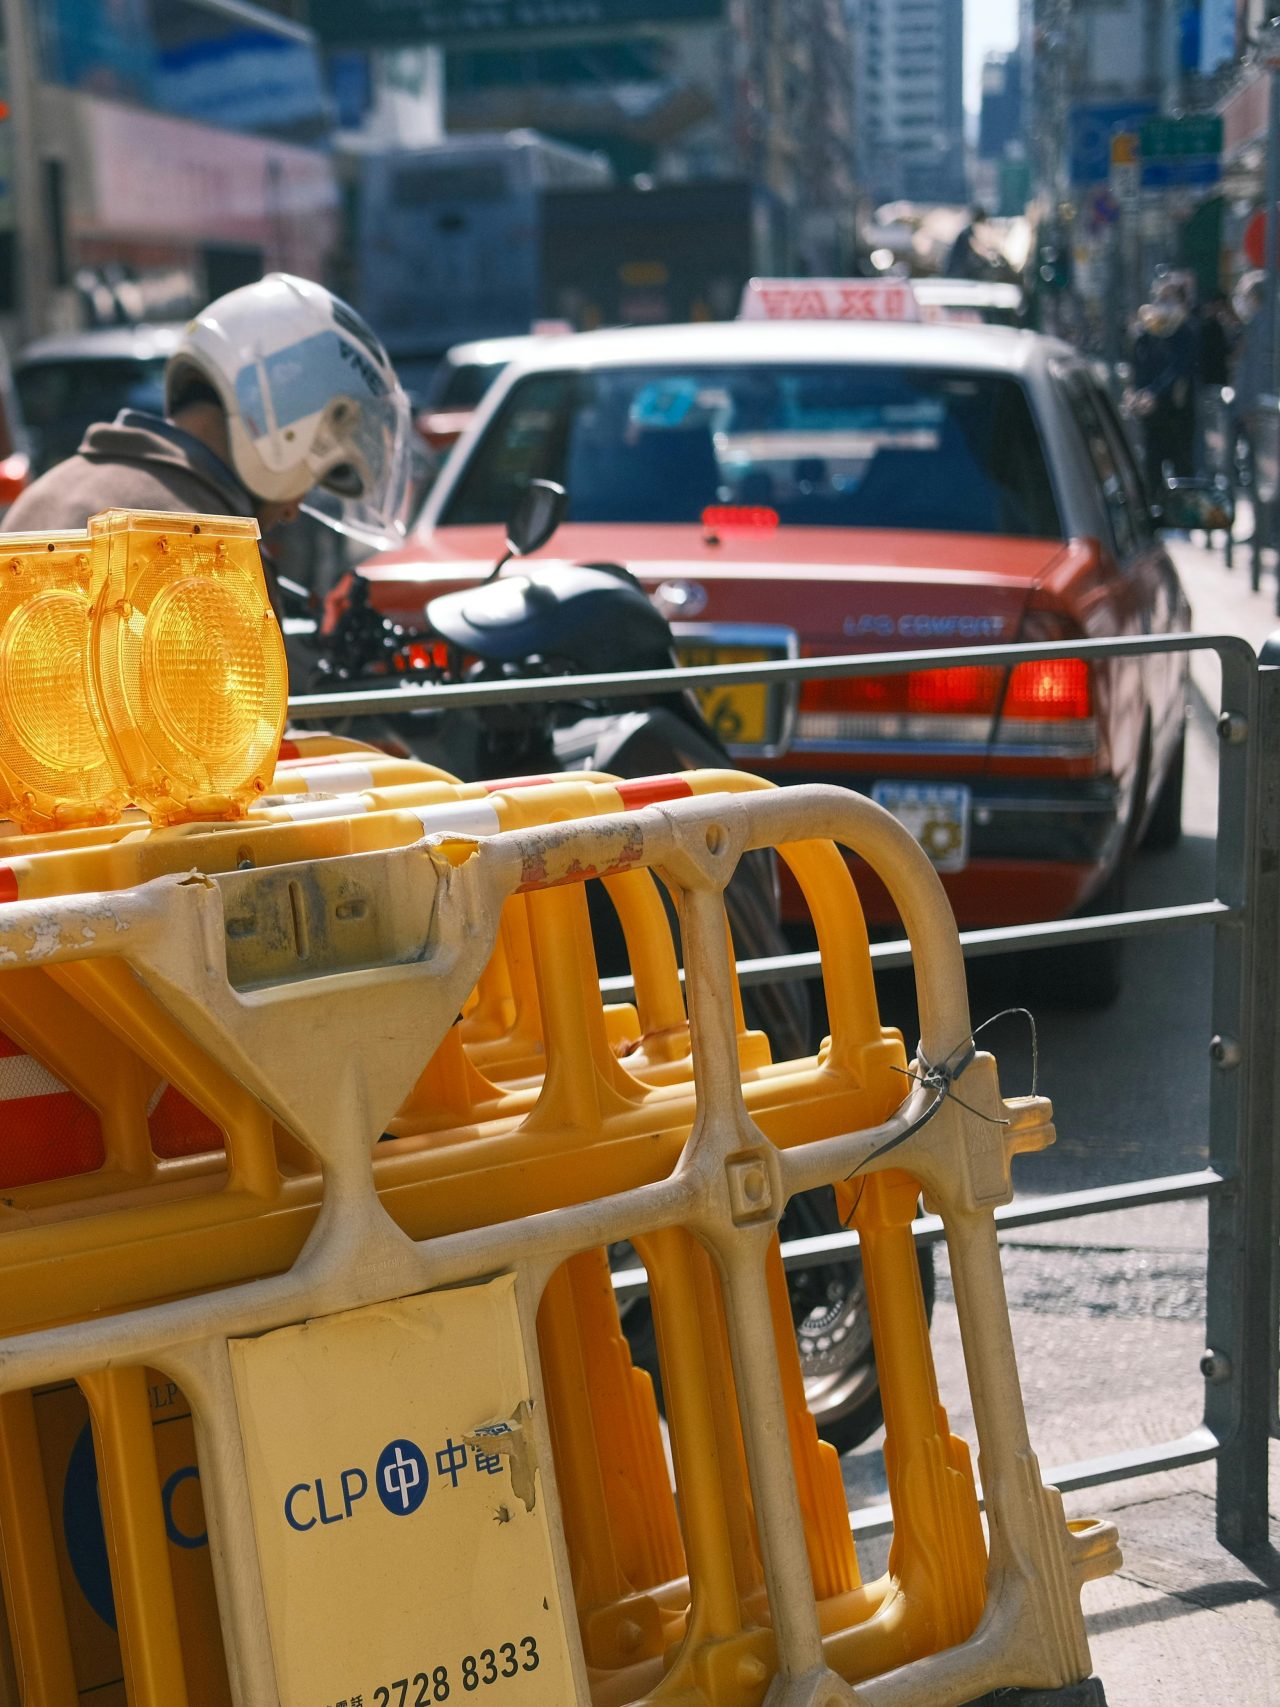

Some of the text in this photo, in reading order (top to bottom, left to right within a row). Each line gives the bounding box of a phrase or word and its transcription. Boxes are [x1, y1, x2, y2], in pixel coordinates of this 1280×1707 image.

[759, 288, 907, 320] TAXI
[284, 1467, 368, 1532] CLP
[372, 1635, 540, 1707] 2728 8333
